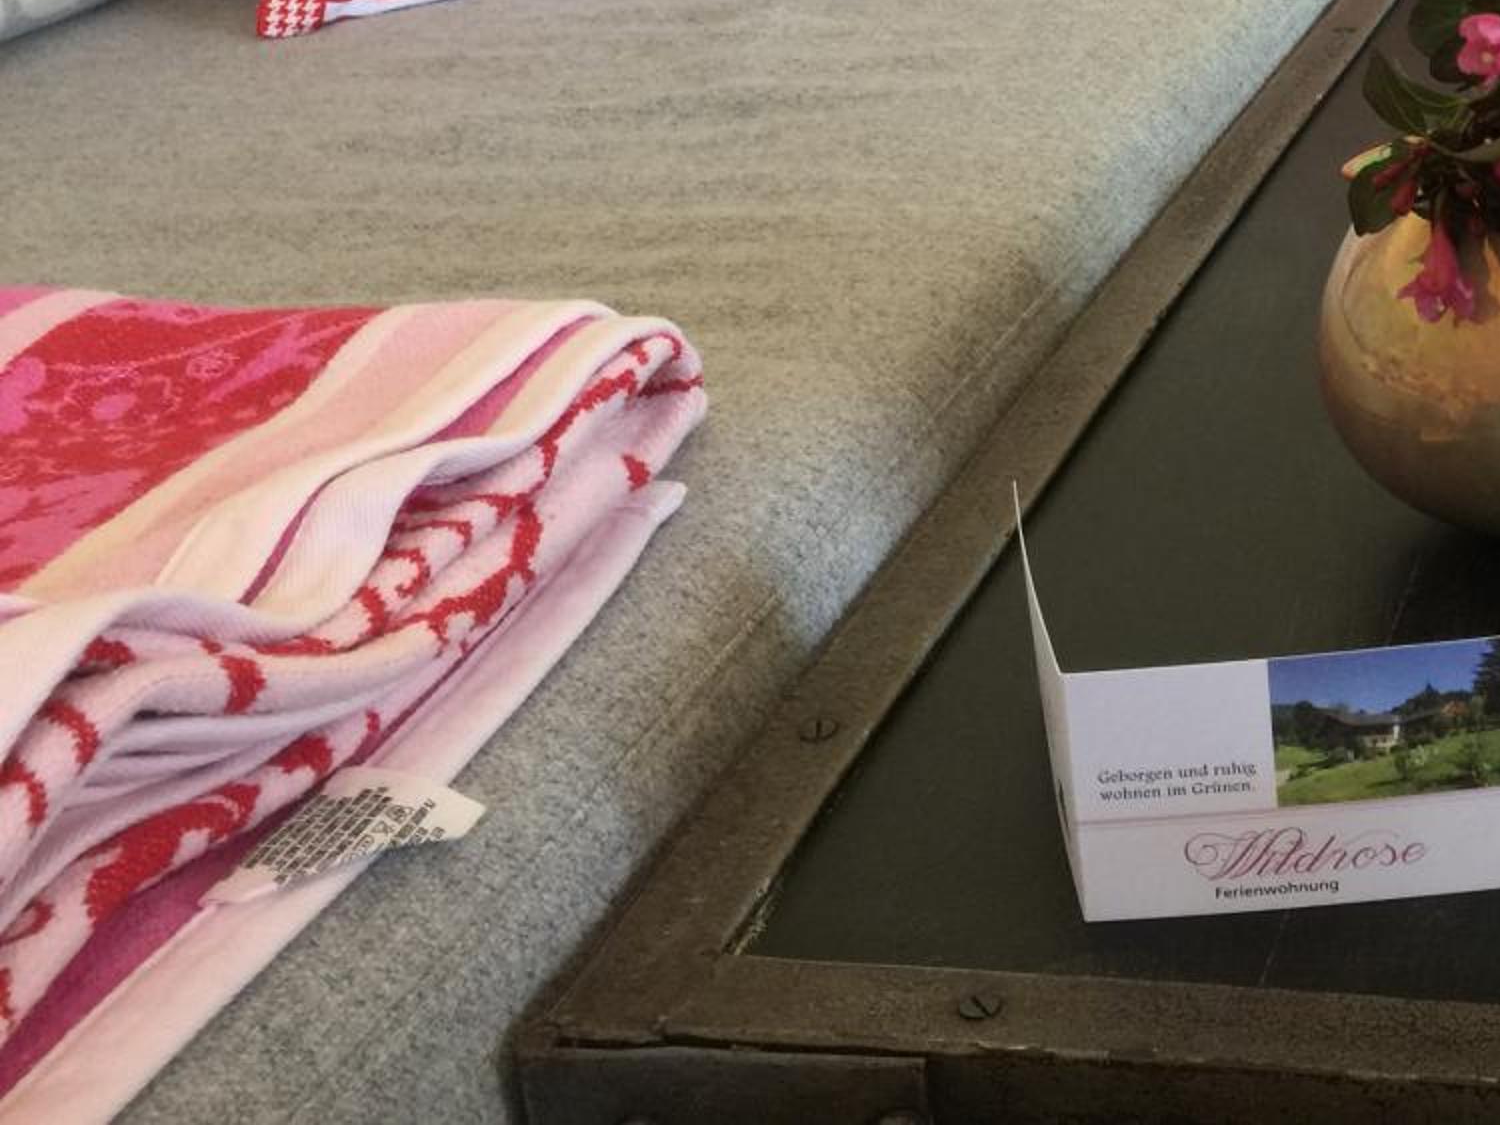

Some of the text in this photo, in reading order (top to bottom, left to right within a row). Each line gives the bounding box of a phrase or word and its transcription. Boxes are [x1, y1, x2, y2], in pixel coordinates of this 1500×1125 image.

[1097, 761, 1257, 784] Geborgen und ruhig
[1099, 786, 1161, 801] wohnen
[1166, 784, 1187, 797] im
[1184, 826, 1426, 881] Wildrose
[1215, 879, 1340, 900] Ferienwohnung
